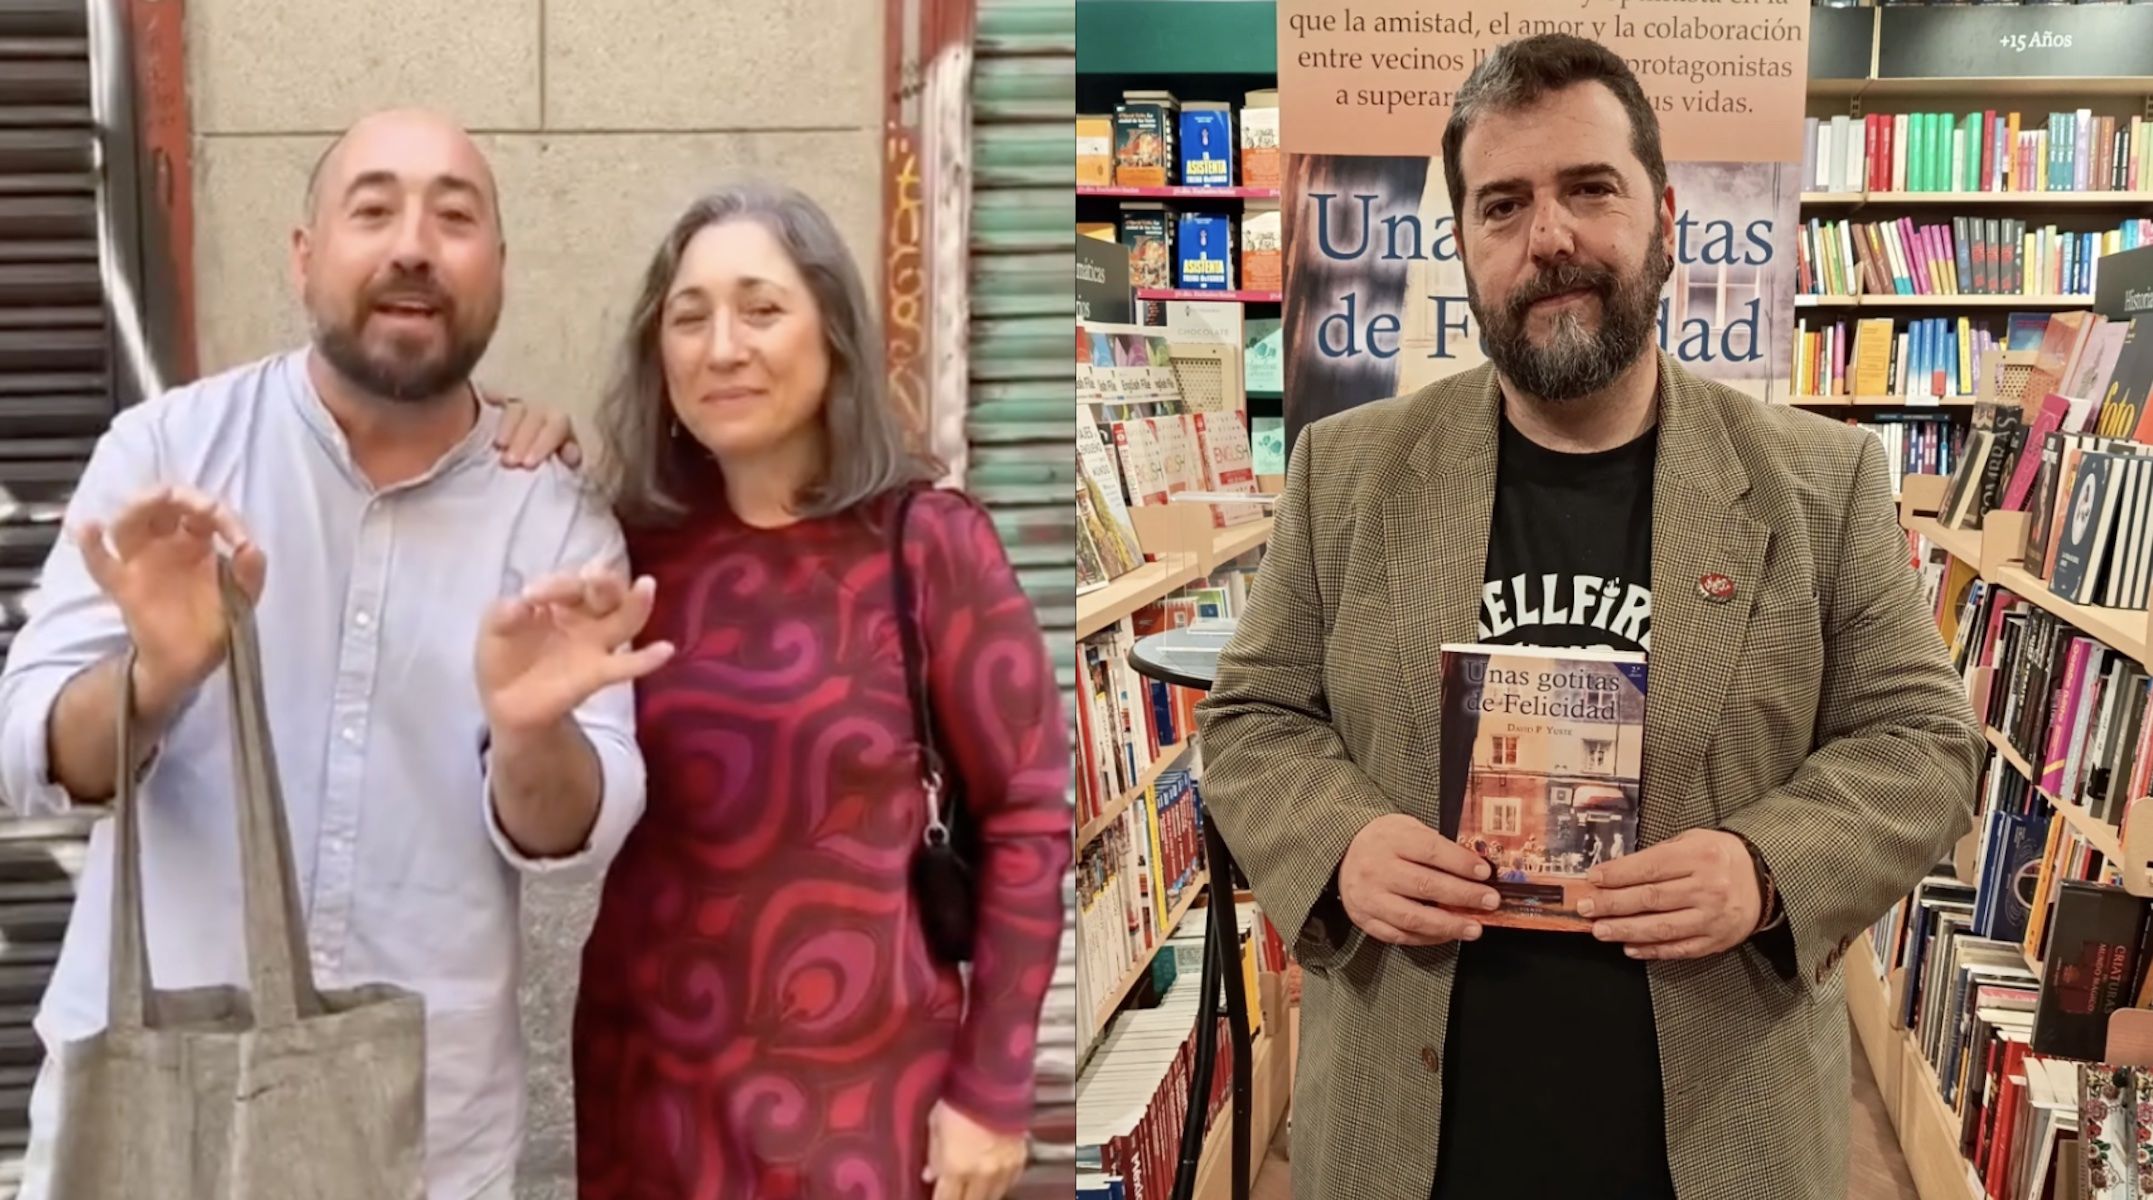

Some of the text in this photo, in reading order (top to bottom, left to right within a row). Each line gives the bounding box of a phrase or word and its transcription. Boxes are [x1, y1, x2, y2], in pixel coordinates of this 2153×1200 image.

[1289, 9, 1803, 42] que la amistad, el amor y la colaboración
[1999, 30, 2073, 52] +15 Años
[1298, 48, 1363, 69] entre
[1371, 49, 1465, 71] vecinos
[1335, 88, 1349, 106] a
[1646, 90, 1753, 114] us vidas.
[1307, 193, 1463, 261] Una
[1318, 291, 1402, 359] de
[1467, 660, 1620, 693] Unas gotitas
[1466, 692, 1616, 720] de Felicidad
[2104, 945, 2128, 1015] CRIATURAS
